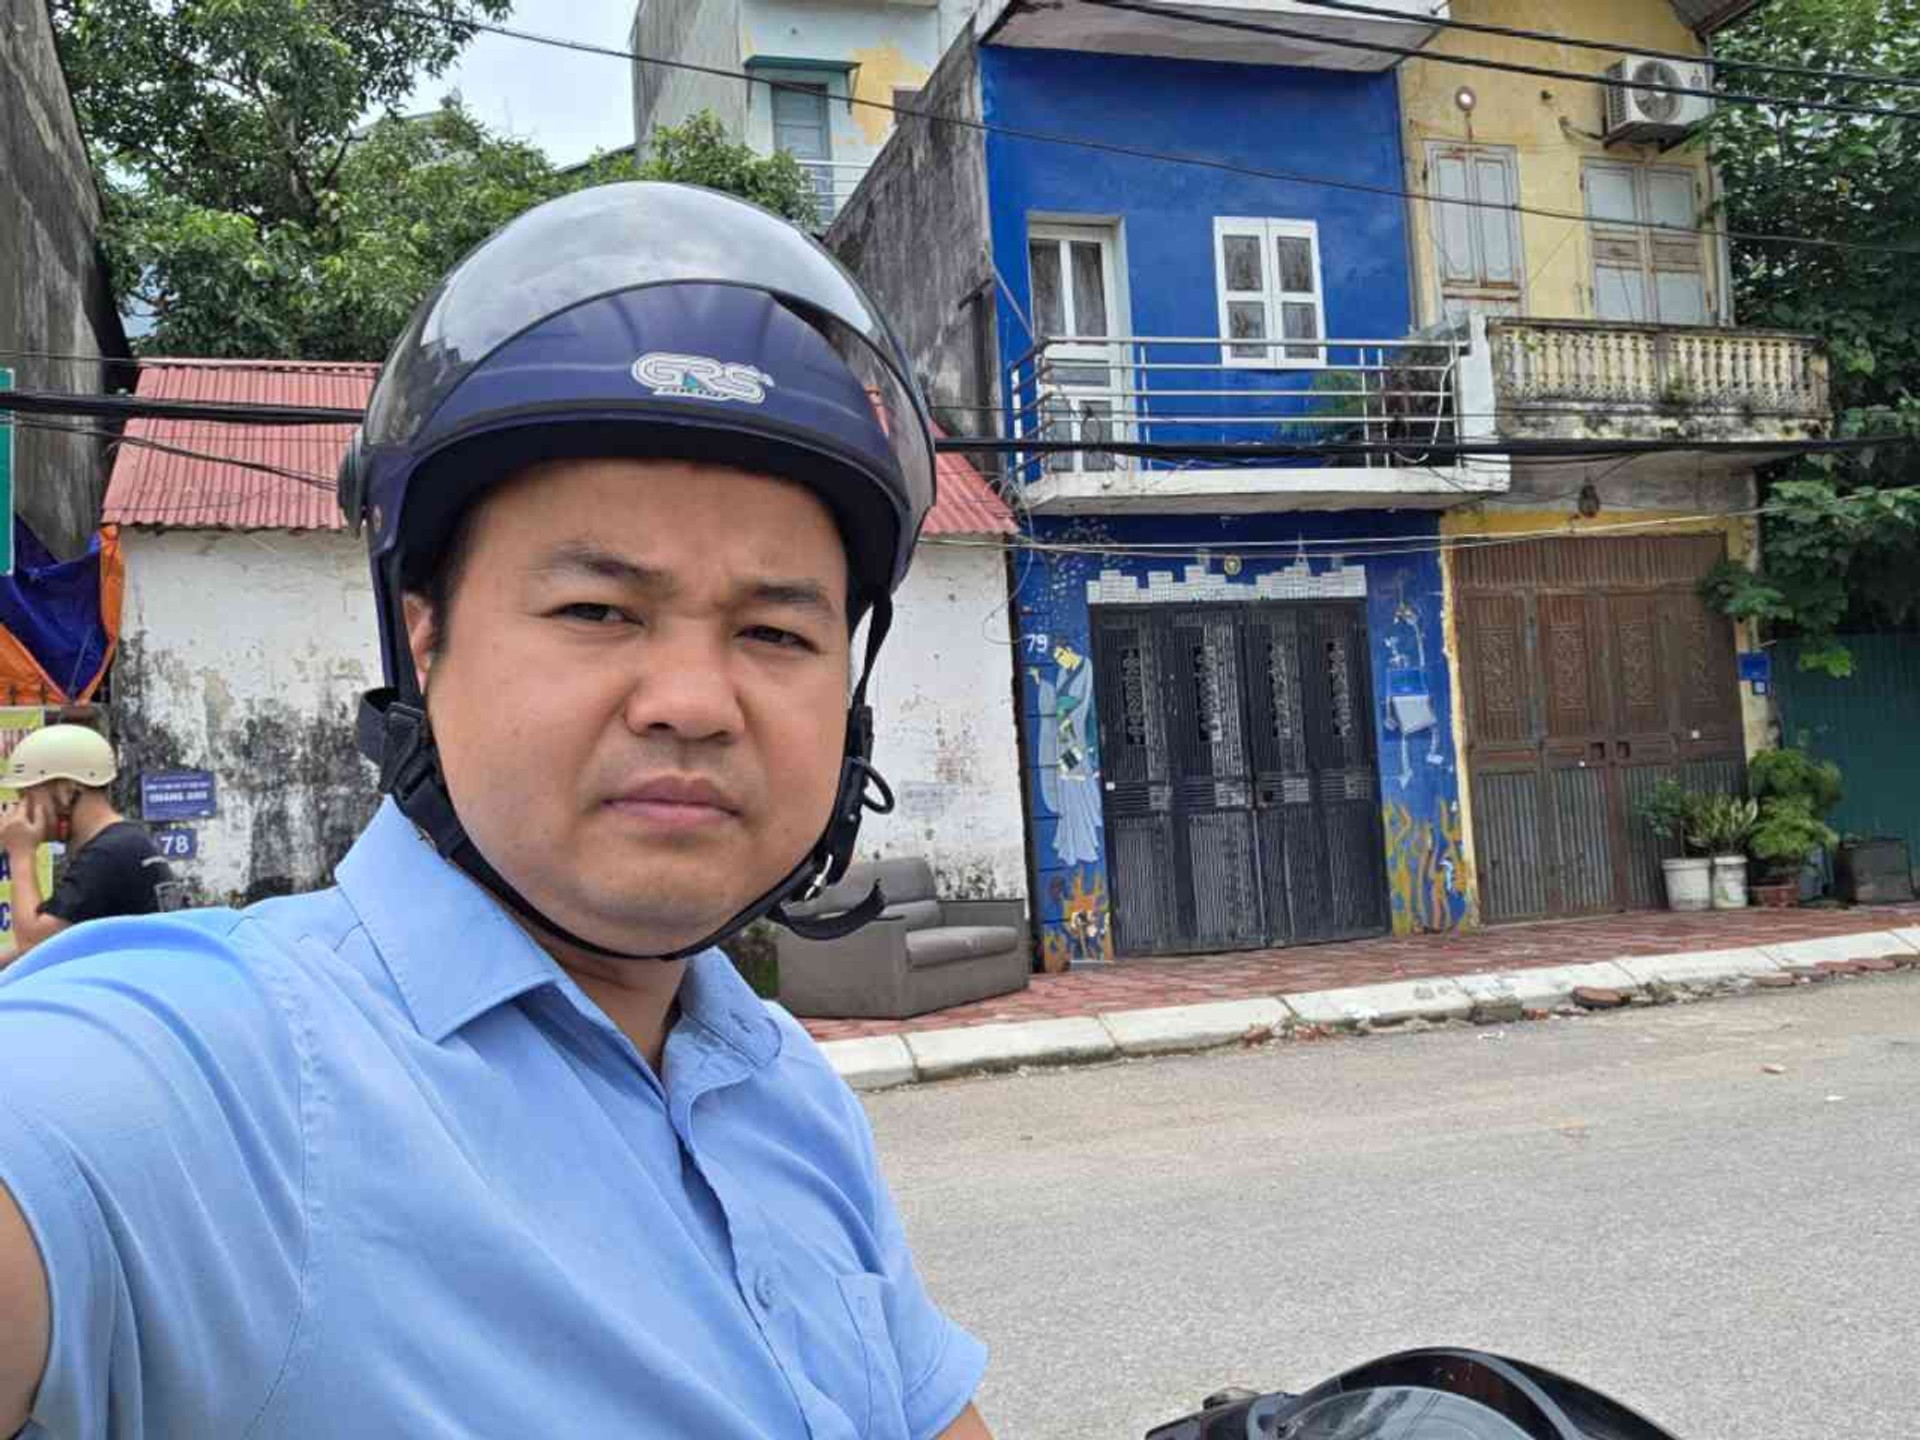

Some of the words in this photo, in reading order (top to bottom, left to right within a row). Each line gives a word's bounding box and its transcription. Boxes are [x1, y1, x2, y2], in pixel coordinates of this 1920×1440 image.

[632, 352, 767, 404] GRS
[1022, 634, 1047, 653] 79
[160, 834, 189, 854] 78
